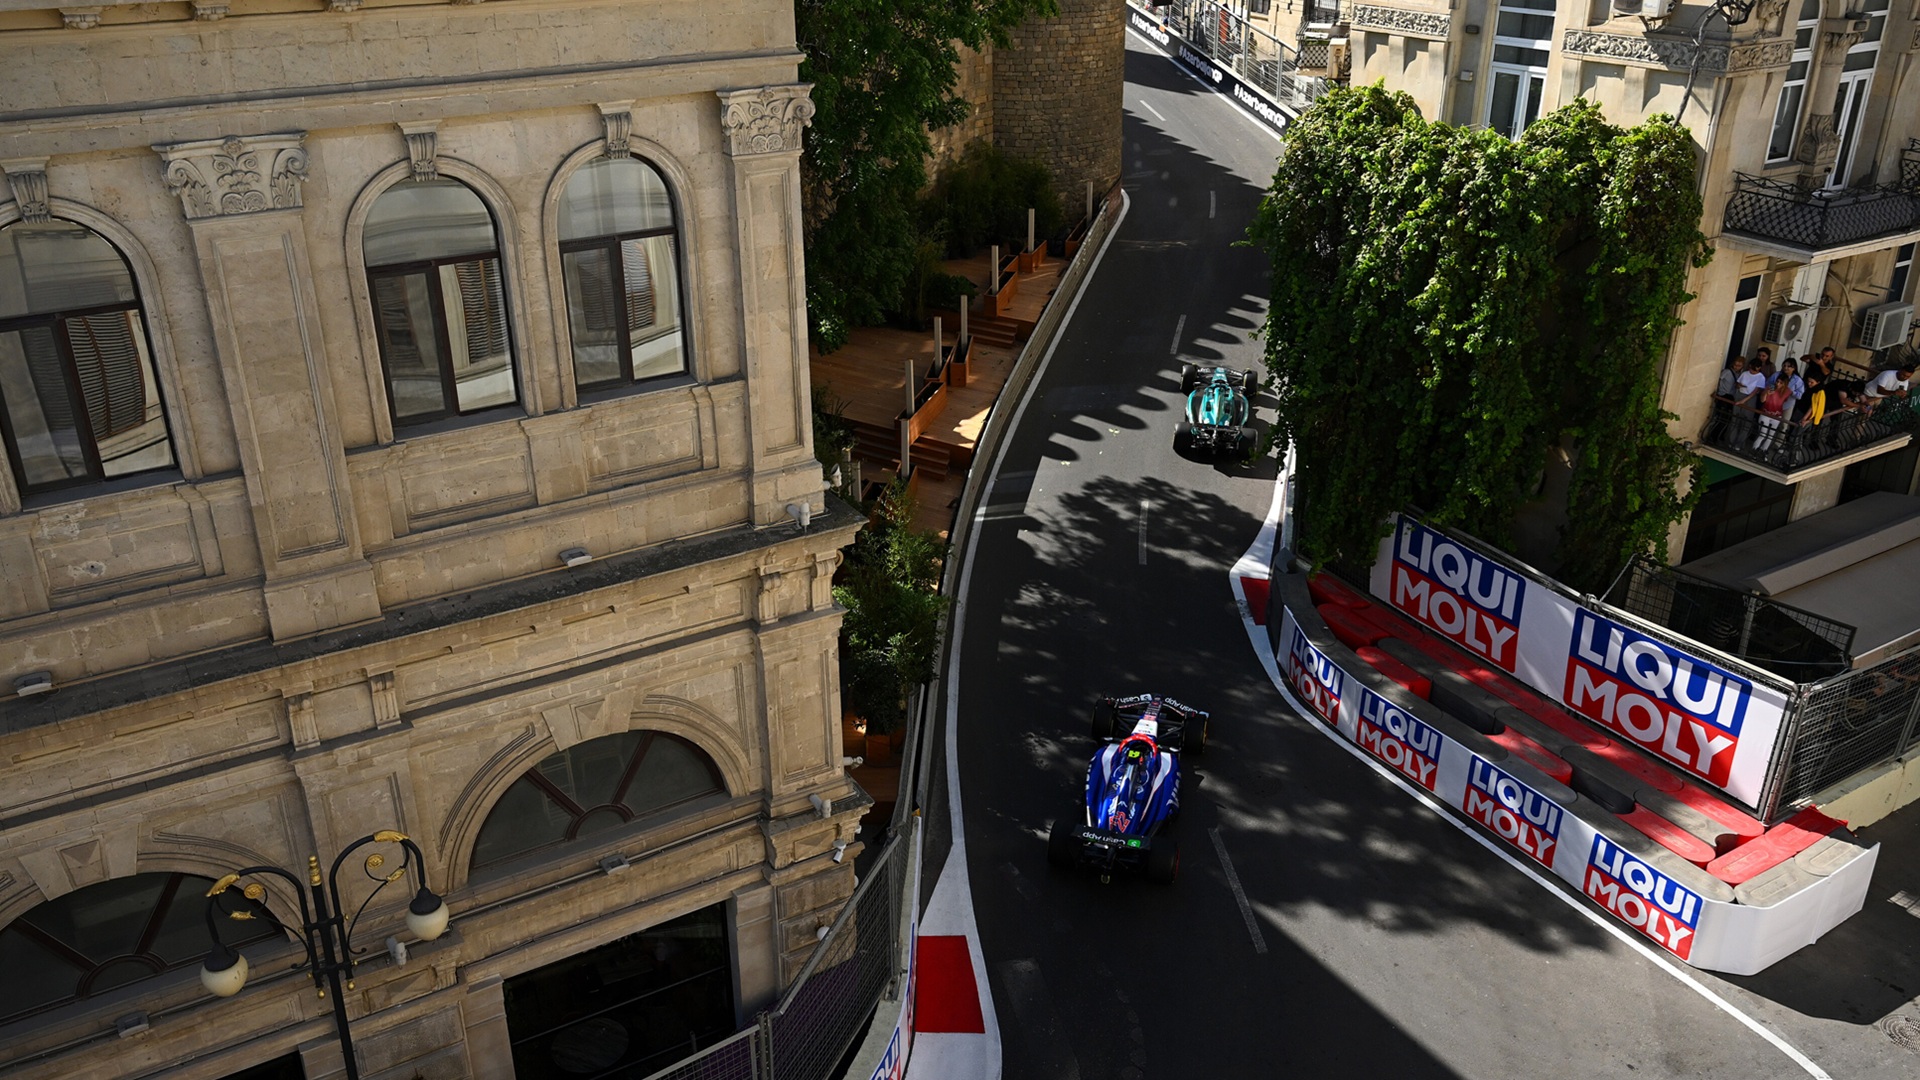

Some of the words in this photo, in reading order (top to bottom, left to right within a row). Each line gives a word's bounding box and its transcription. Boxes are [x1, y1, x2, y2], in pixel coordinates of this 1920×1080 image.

[1399, 521, 1519, 620] LIQUI
[1395, 566, 1517, 662] MOLY
[1290, 655, 1340, 719] MOLY
[1293, 629, 1342, 695] LIQUI
[1577, 615, 1742, 728] LIQUI
[1359, 720, 1436, 785] MOLY
[1362, 692, 1440, 759] LIQUI
[1571, 664, 1735, 775] MOLY
[1467, 788, 1555, 860] MOLY
[1471, 759, 1560, 835] LIQUI
[1588, 869, 1695, 951] MOLY
[1593, 838, 1696, 924] LIQUI
